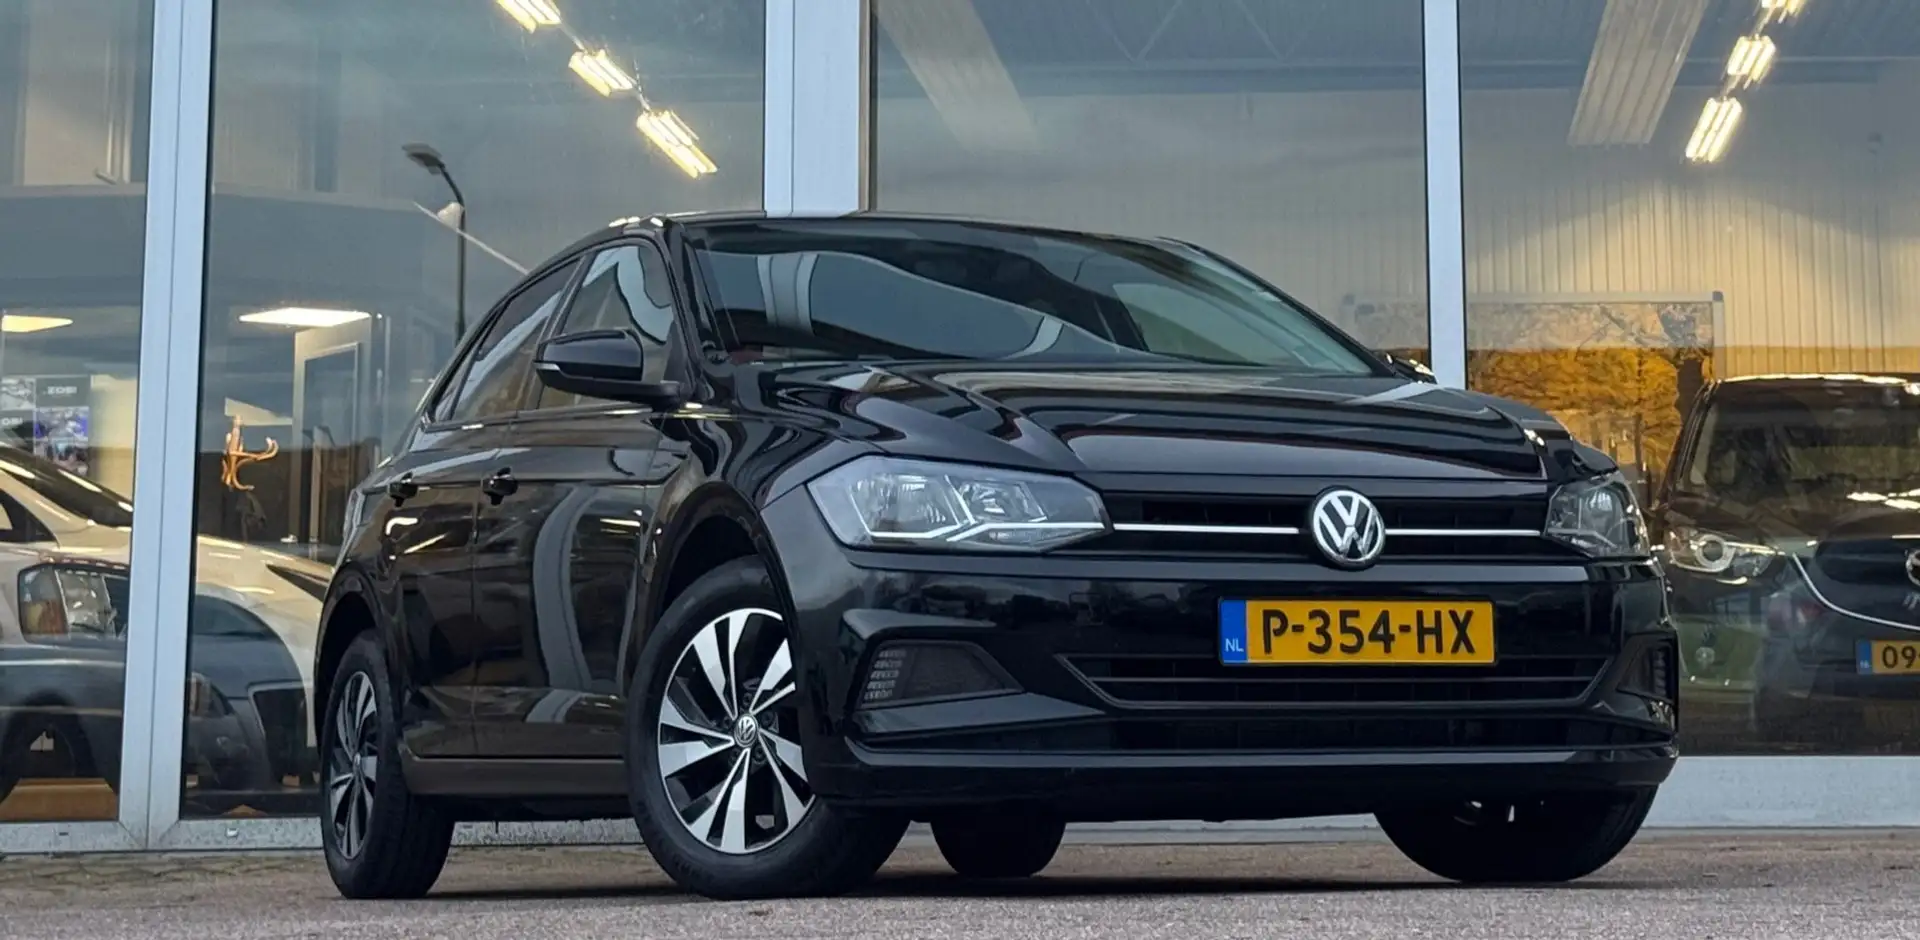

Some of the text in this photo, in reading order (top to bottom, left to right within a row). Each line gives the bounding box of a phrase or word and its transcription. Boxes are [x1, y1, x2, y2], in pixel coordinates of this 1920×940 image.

[1225, 608, 1475, 655] NL P-354-HX
[1882, 644, 1920, 669] 09
